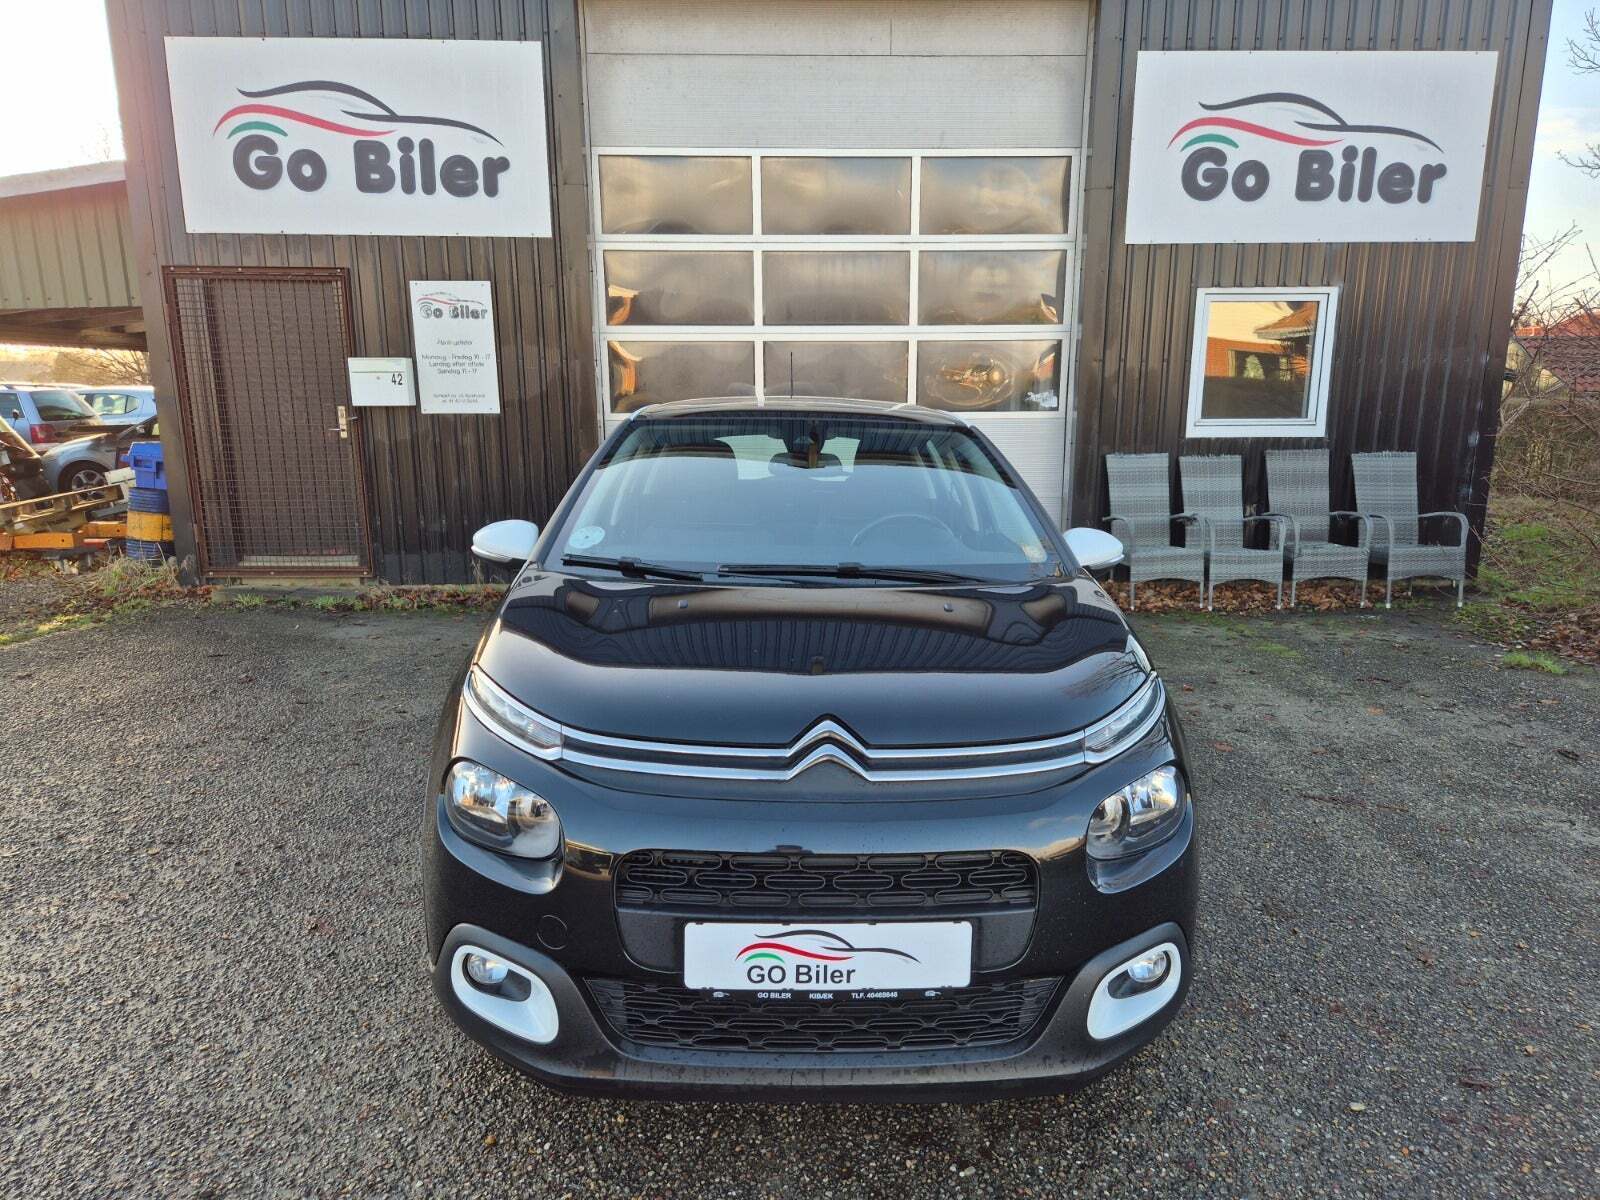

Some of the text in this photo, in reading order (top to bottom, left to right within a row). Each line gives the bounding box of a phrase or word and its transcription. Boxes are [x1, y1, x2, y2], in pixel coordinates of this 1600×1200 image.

[232, 133, 511, 198] Go Biler
[1180, 144, 1448, 205] Go Biler
[419, 304, 488, 320] Go Biler
[391, 373, 403, 386] 42
[746, 963, 856, 984] GO Biler
